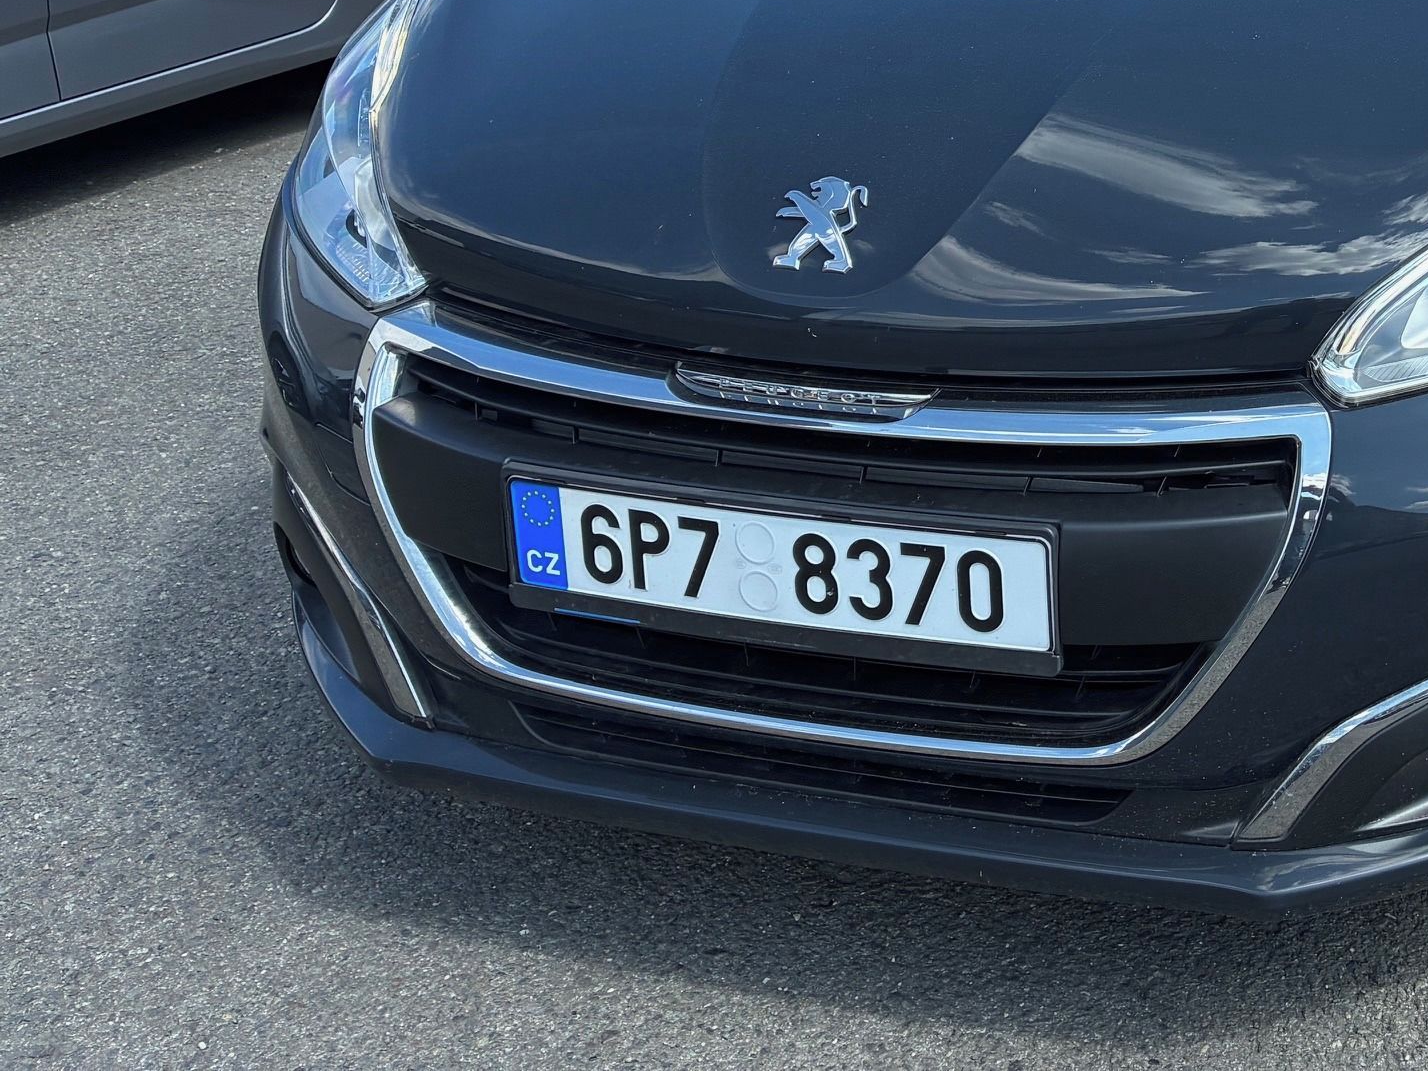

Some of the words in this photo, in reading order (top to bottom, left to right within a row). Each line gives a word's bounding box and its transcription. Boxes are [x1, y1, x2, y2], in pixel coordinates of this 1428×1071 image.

[719, 377, 881, 406] PEUGEOT
[526, 548, 562, 577] CZ
[579, 503, 720, 598] 6P7
[791, 532, 1005, 633] 8370
